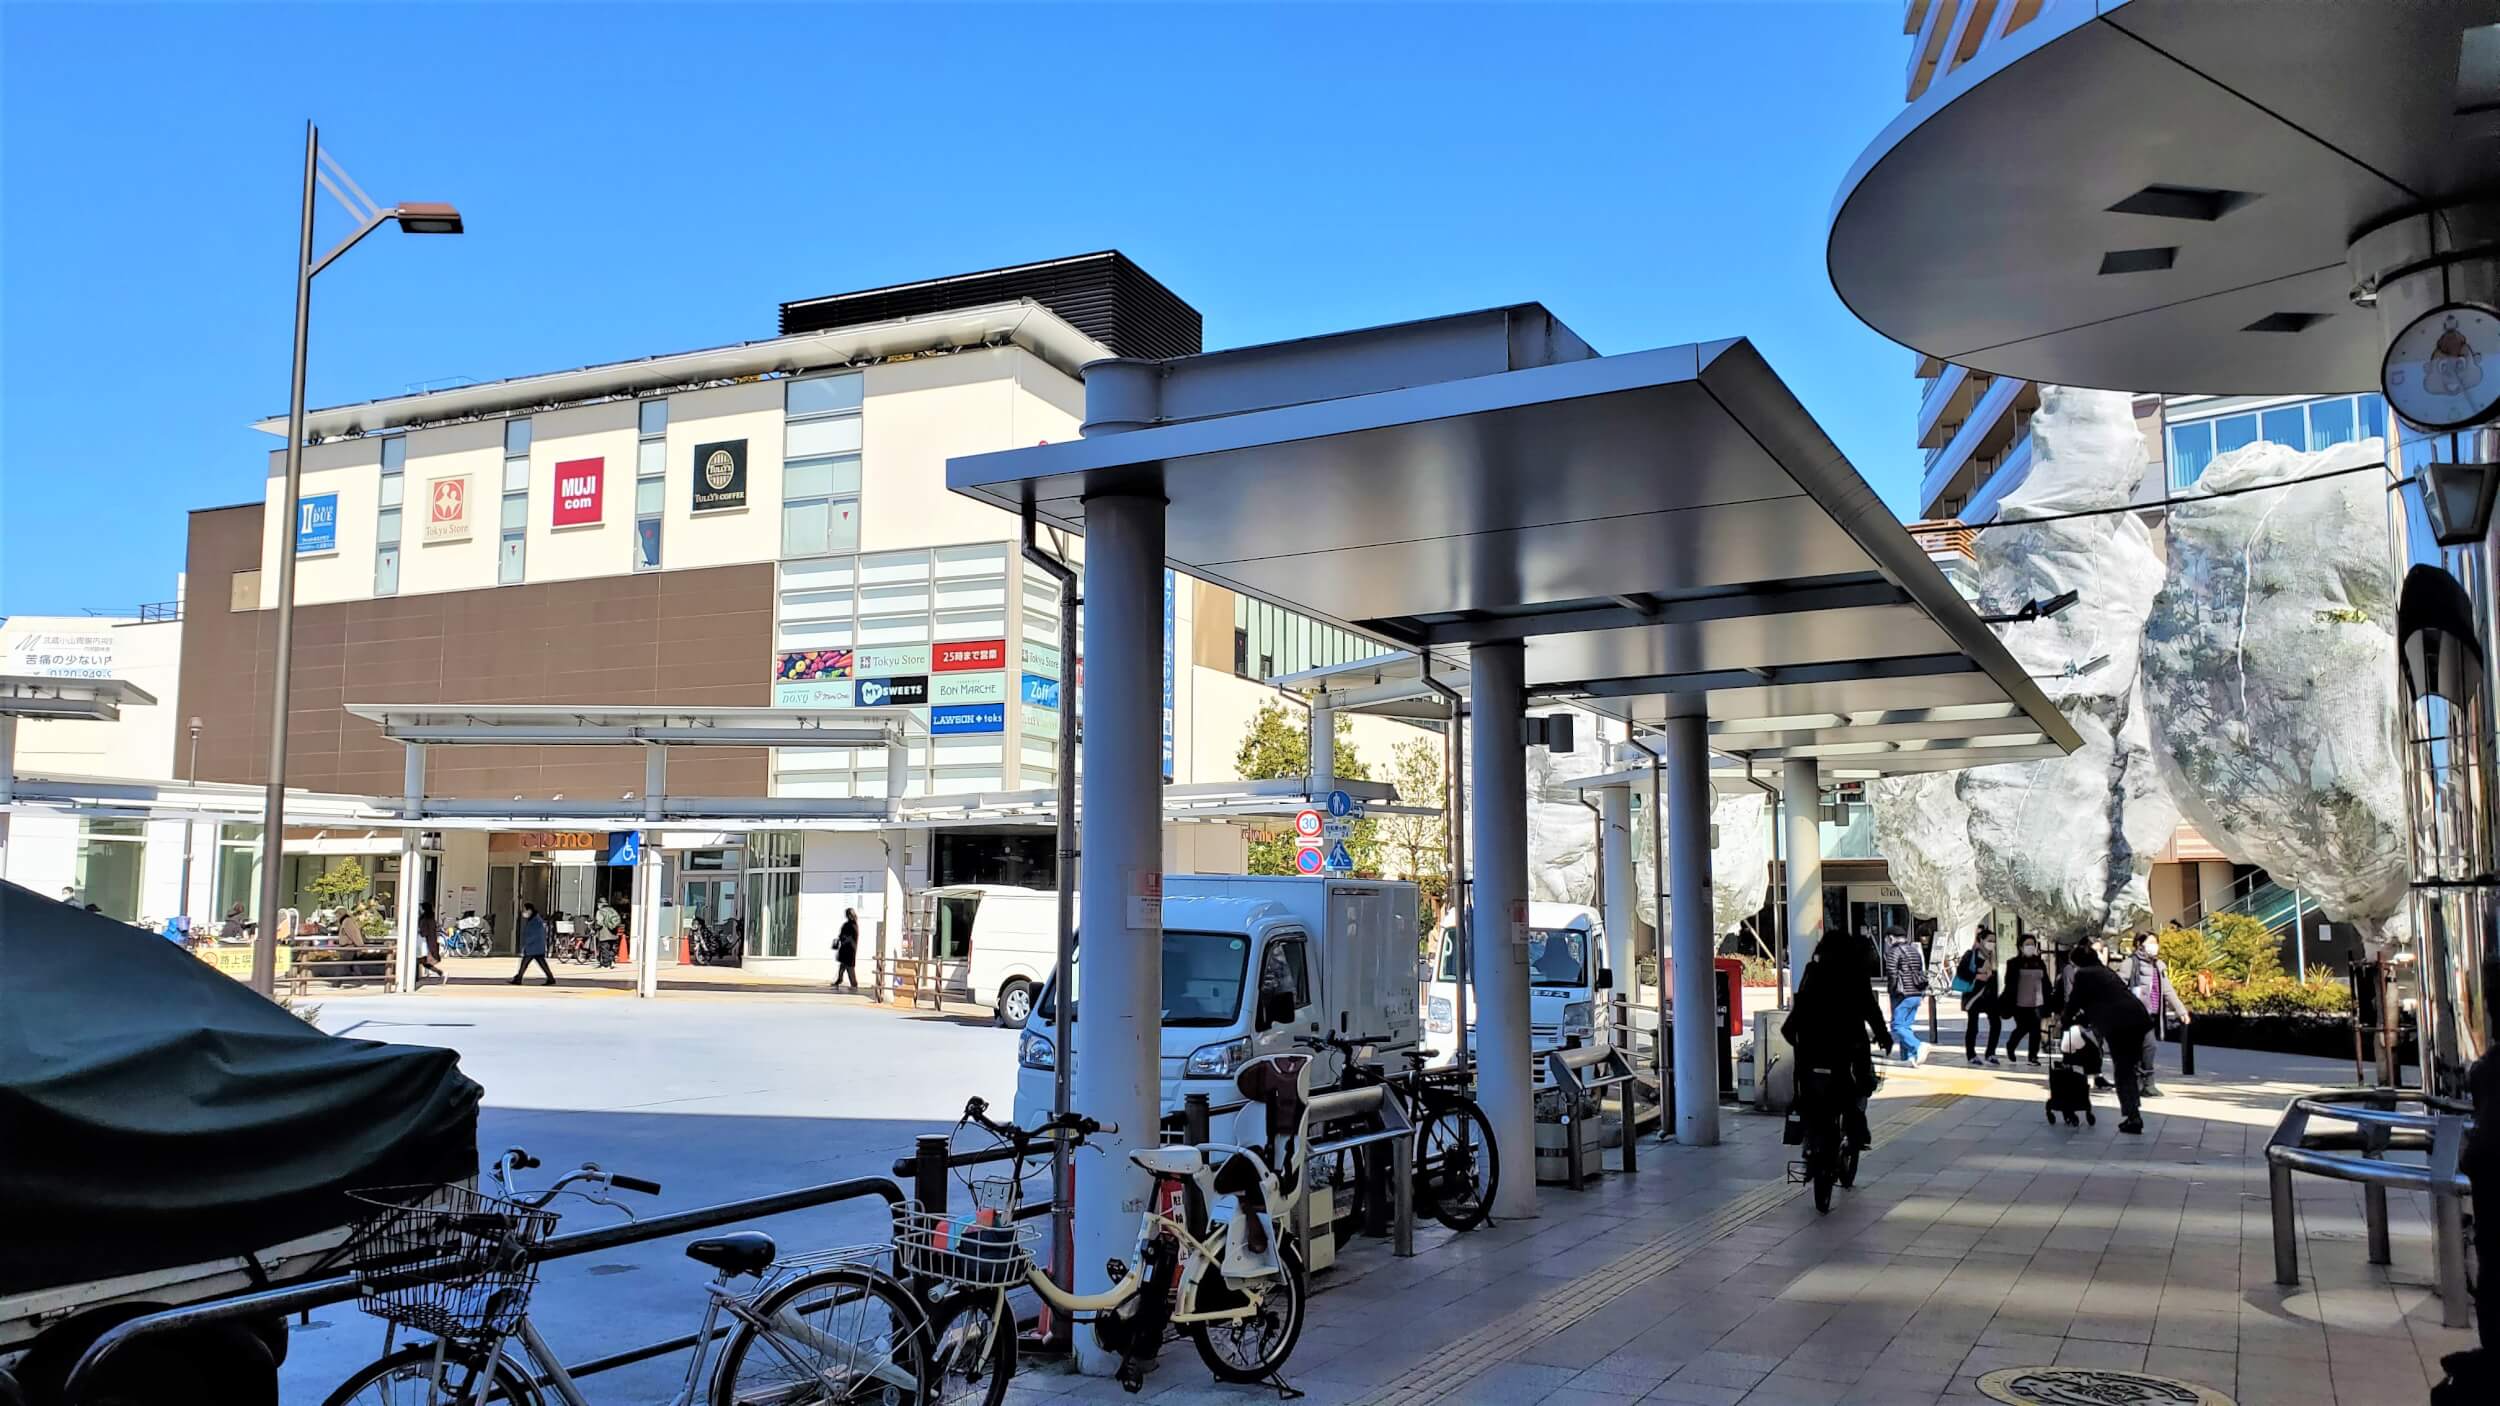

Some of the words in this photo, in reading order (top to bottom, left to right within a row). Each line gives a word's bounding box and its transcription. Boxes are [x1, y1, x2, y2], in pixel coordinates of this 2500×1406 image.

[562, 475, 596, 497] MUJI
[564, 498, 592, 509] com
[873, 655, 899, 667] Tokyu
[901, 654, 926, 665] Store
[865, 687, 881, 697] MY
[883, 685, 922, 696] SWEETS
[940, 685, 958, 696] BON
[960, 684, 997, 695] MARCHE
[1030, 681, 1049, 700] Zoff
[782, 693, 809, 704] DONQ
[933, 715, 974, 725] LAWSON
[1301, 817, 1317, 830] 30
